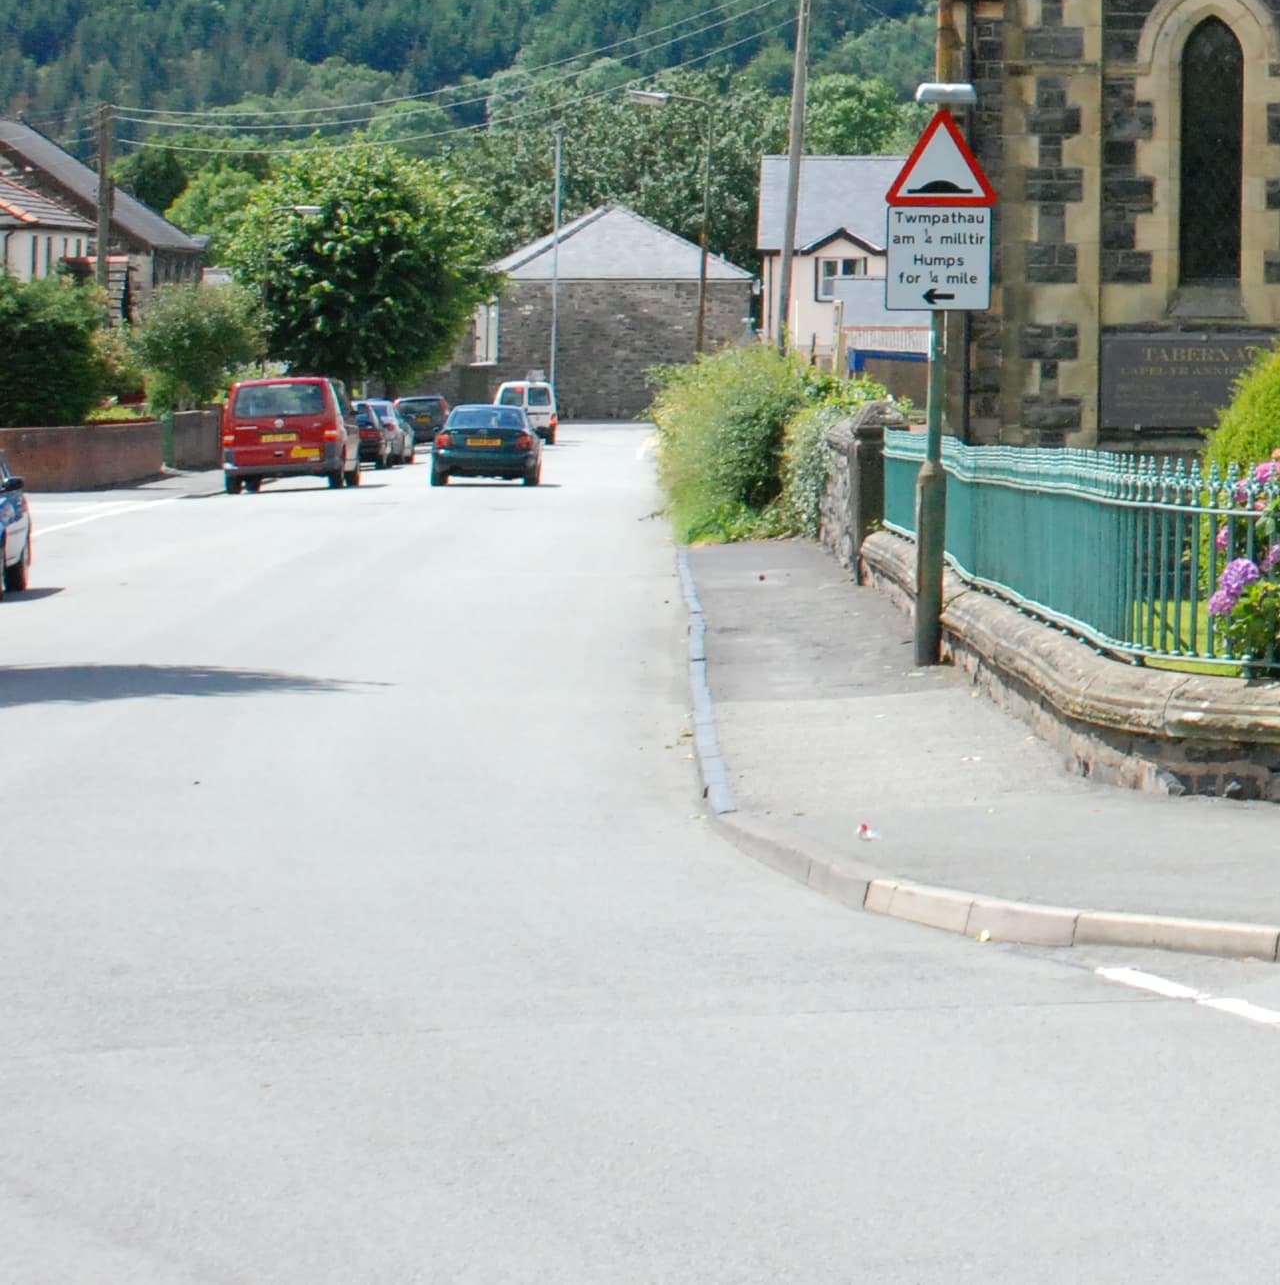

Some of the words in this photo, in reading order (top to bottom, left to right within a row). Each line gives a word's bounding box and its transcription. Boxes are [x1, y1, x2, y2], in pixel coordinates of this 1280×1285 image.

[895, 211, 985, 226] Twmpathau
[892, 234, 915, 245] am
[940, 233, 985, 245] milltir
[913, 254, 964, 269] Humps
[899, 272, 921, 284] for
[946, 272, 978, 284] mile
[1142, 346, 1256, 362] TABERNAC
